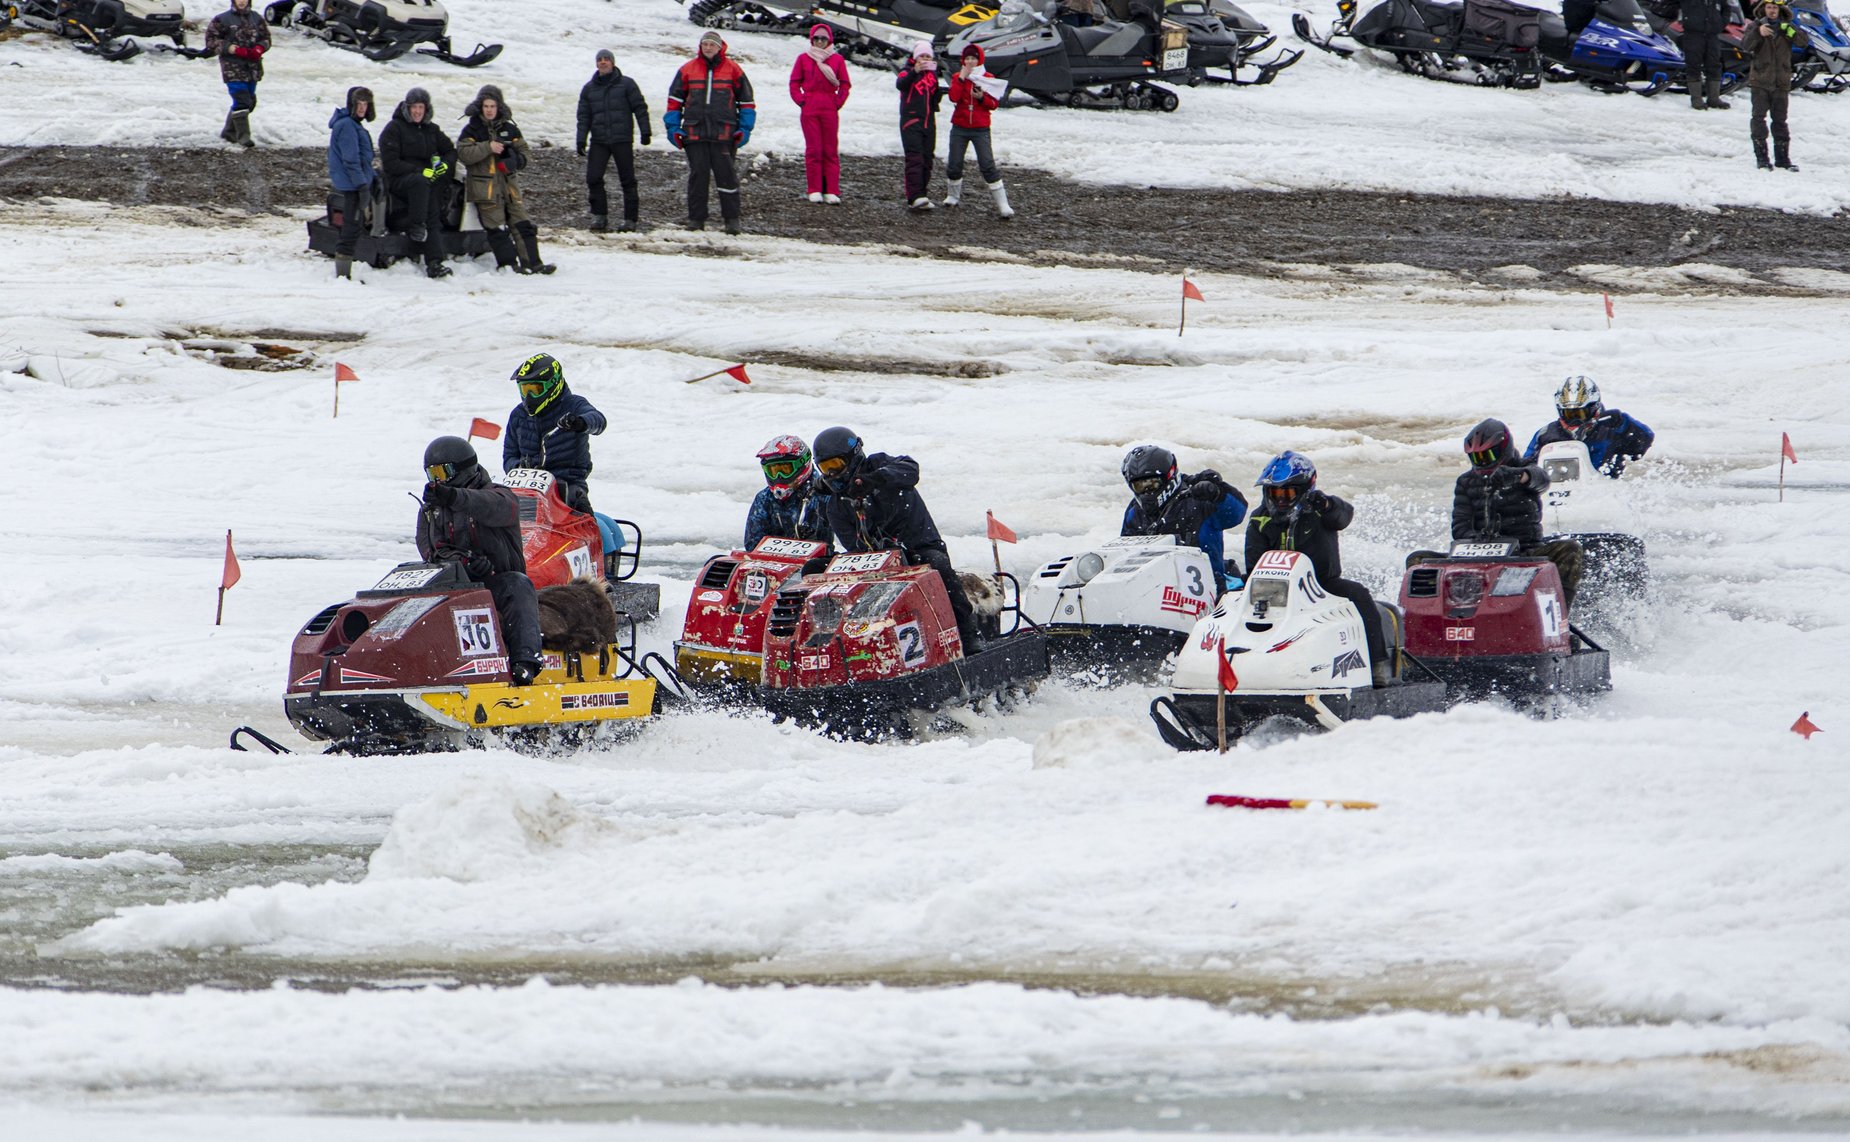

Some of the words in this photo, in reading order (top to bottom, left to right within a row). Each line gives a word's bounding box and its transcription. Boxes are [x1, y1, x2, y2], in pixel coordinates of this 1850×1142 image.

[508, 469, 548, 481] 0514
[529, 481, 546, 490] 83
[772, 539, 812, 549] 9970
[1463, 543, 1504, 551] 1508
[842, 553, 883, 565] 7812
[861, 562, 879, 570] 83
[395, 569, 435, 580] 1827
[378, 581, 401, 589] ОН
[406, 579, 425, 588] 83
[1185, 565, 1205, 597] 3
[1298, 570, 1327, 604] 10
[1545, 599, 1556, 633] 1
[460, 618, 491, 650] 16
[1447, 627, 1475, 640] 640
[898, 626, 924, 663] 2
[476, 658, 506, 673] БУРАН
